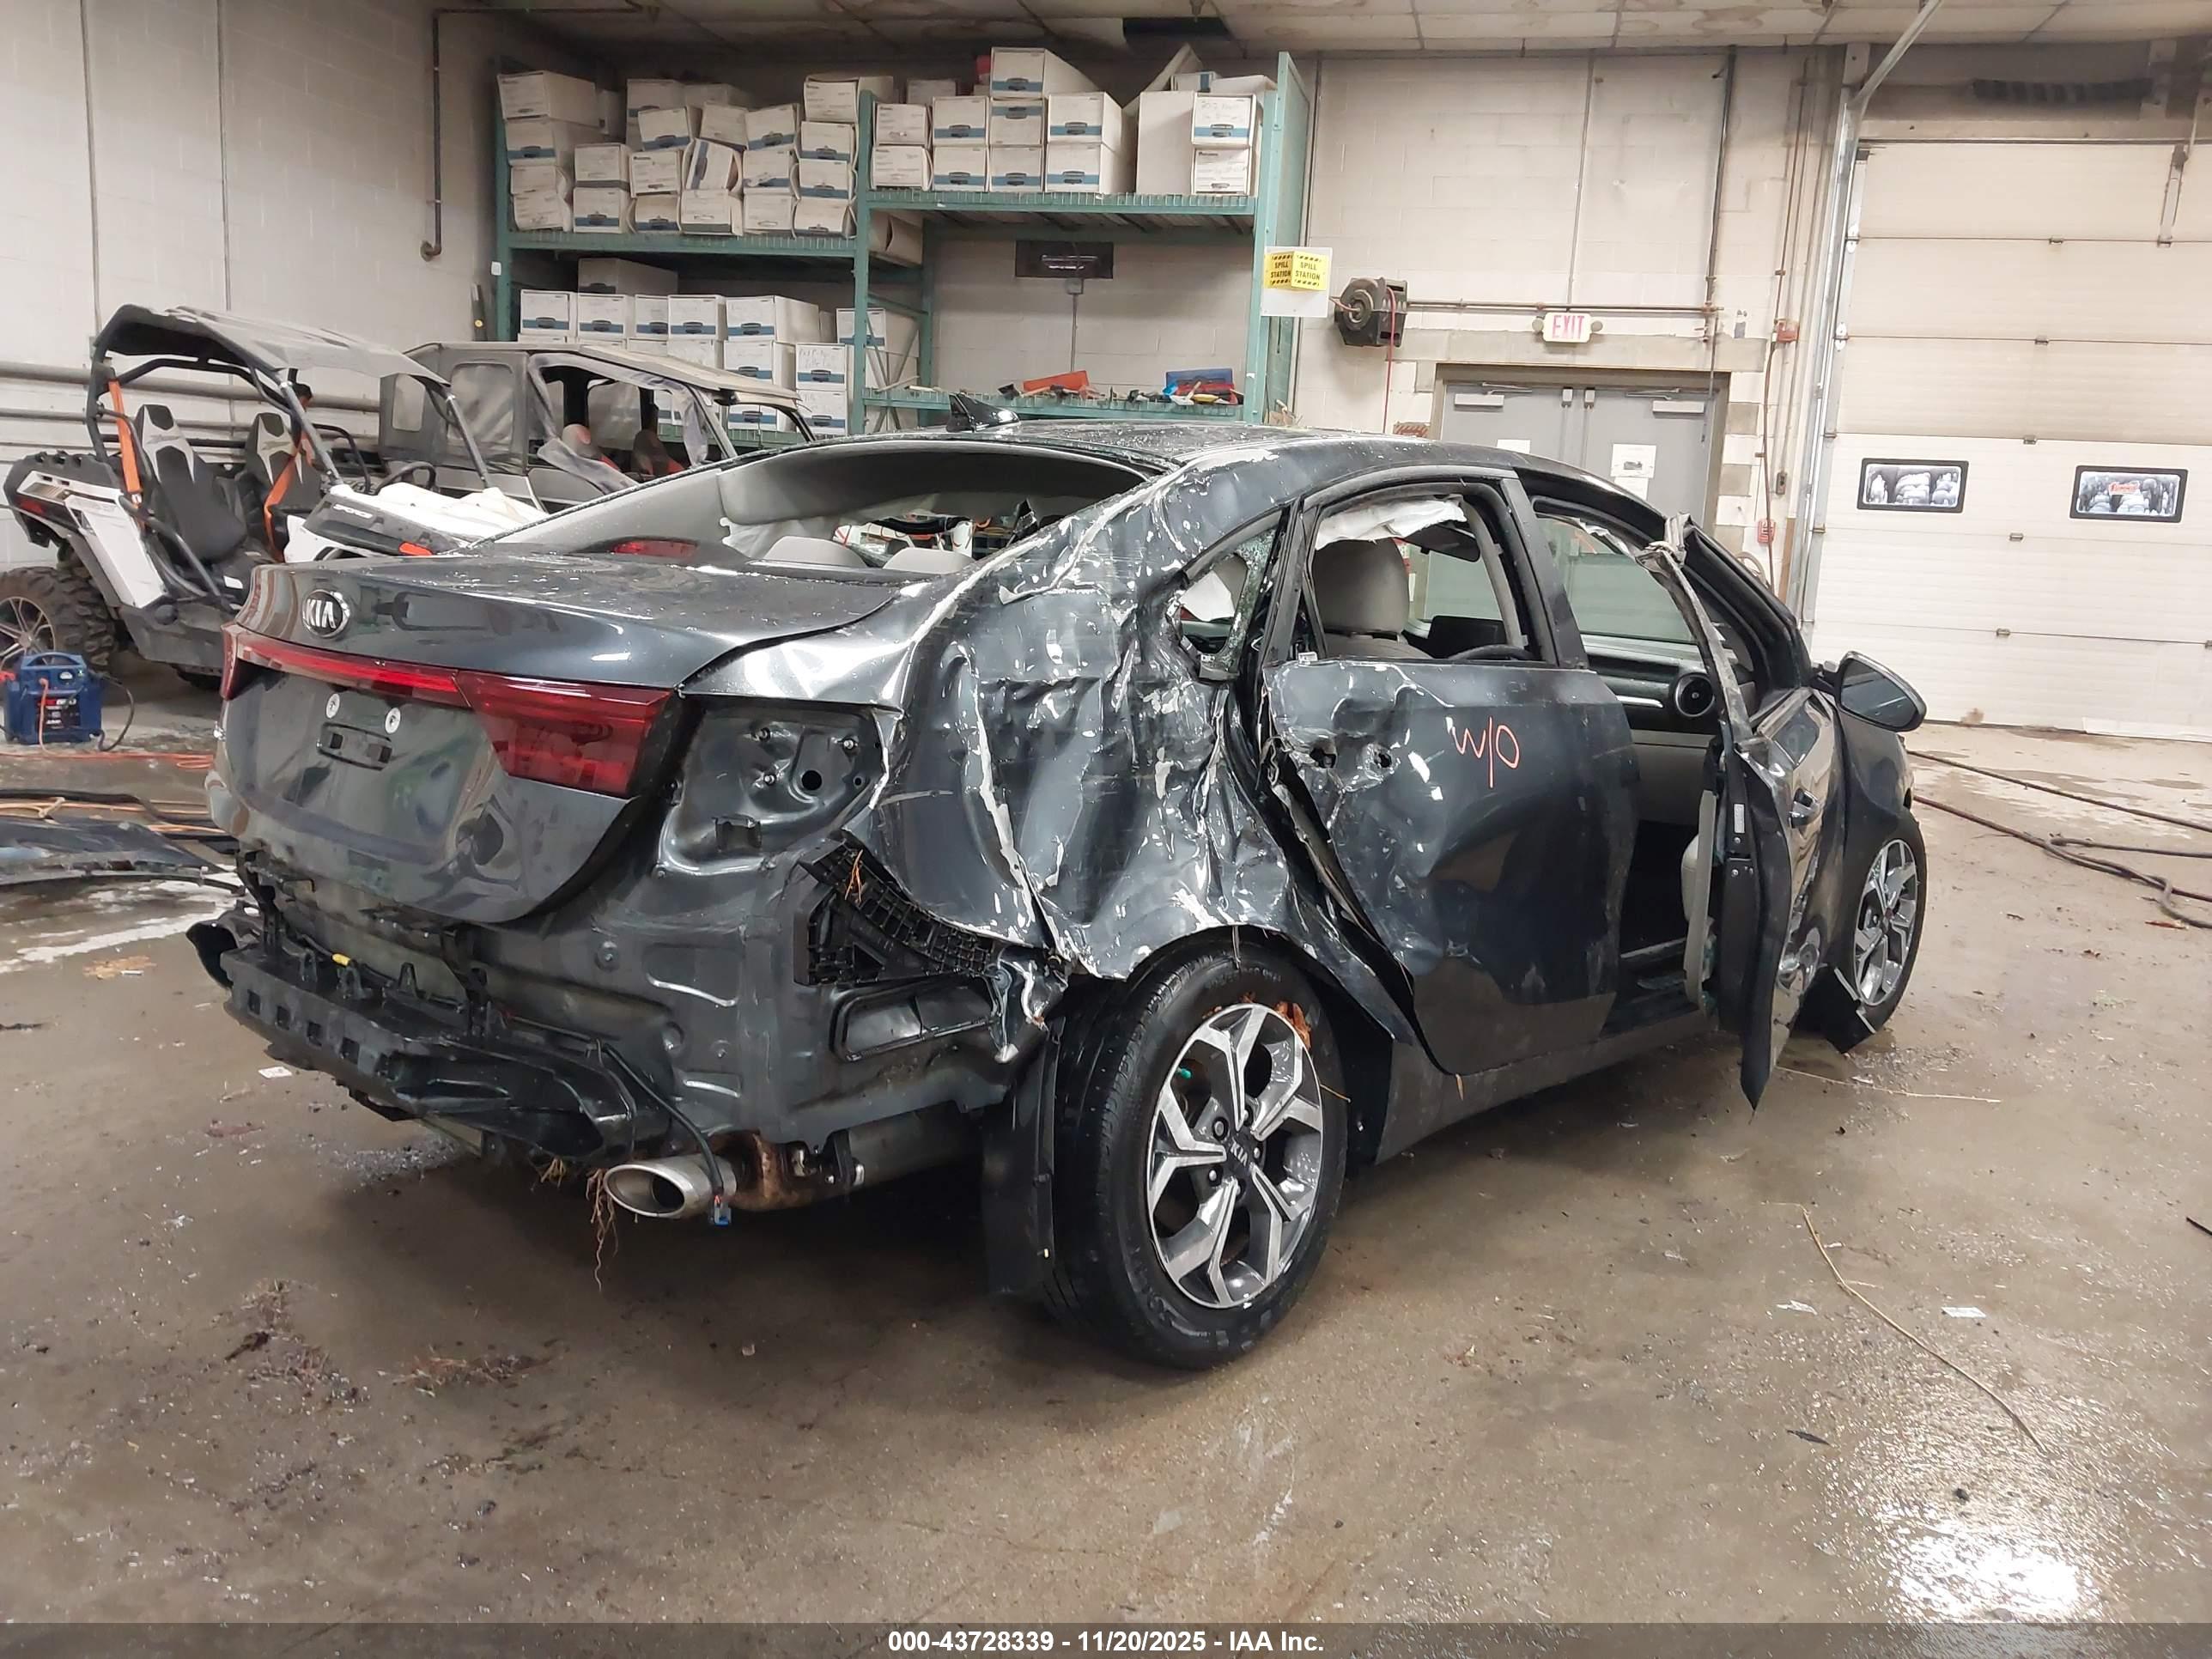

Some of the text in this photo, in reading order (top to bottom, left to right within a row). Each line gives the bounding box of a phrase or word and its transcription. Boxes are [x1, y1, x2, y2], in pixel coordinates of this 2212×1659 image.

[1295, 270, 1321, 280] STATION
[1300, 262, 1317, 270] SPILL
[1552, 314, 1585, 339] EXIT
[306, 598, 337, 629] KIA
[1230, 1140, 1249, 1166] KIA
